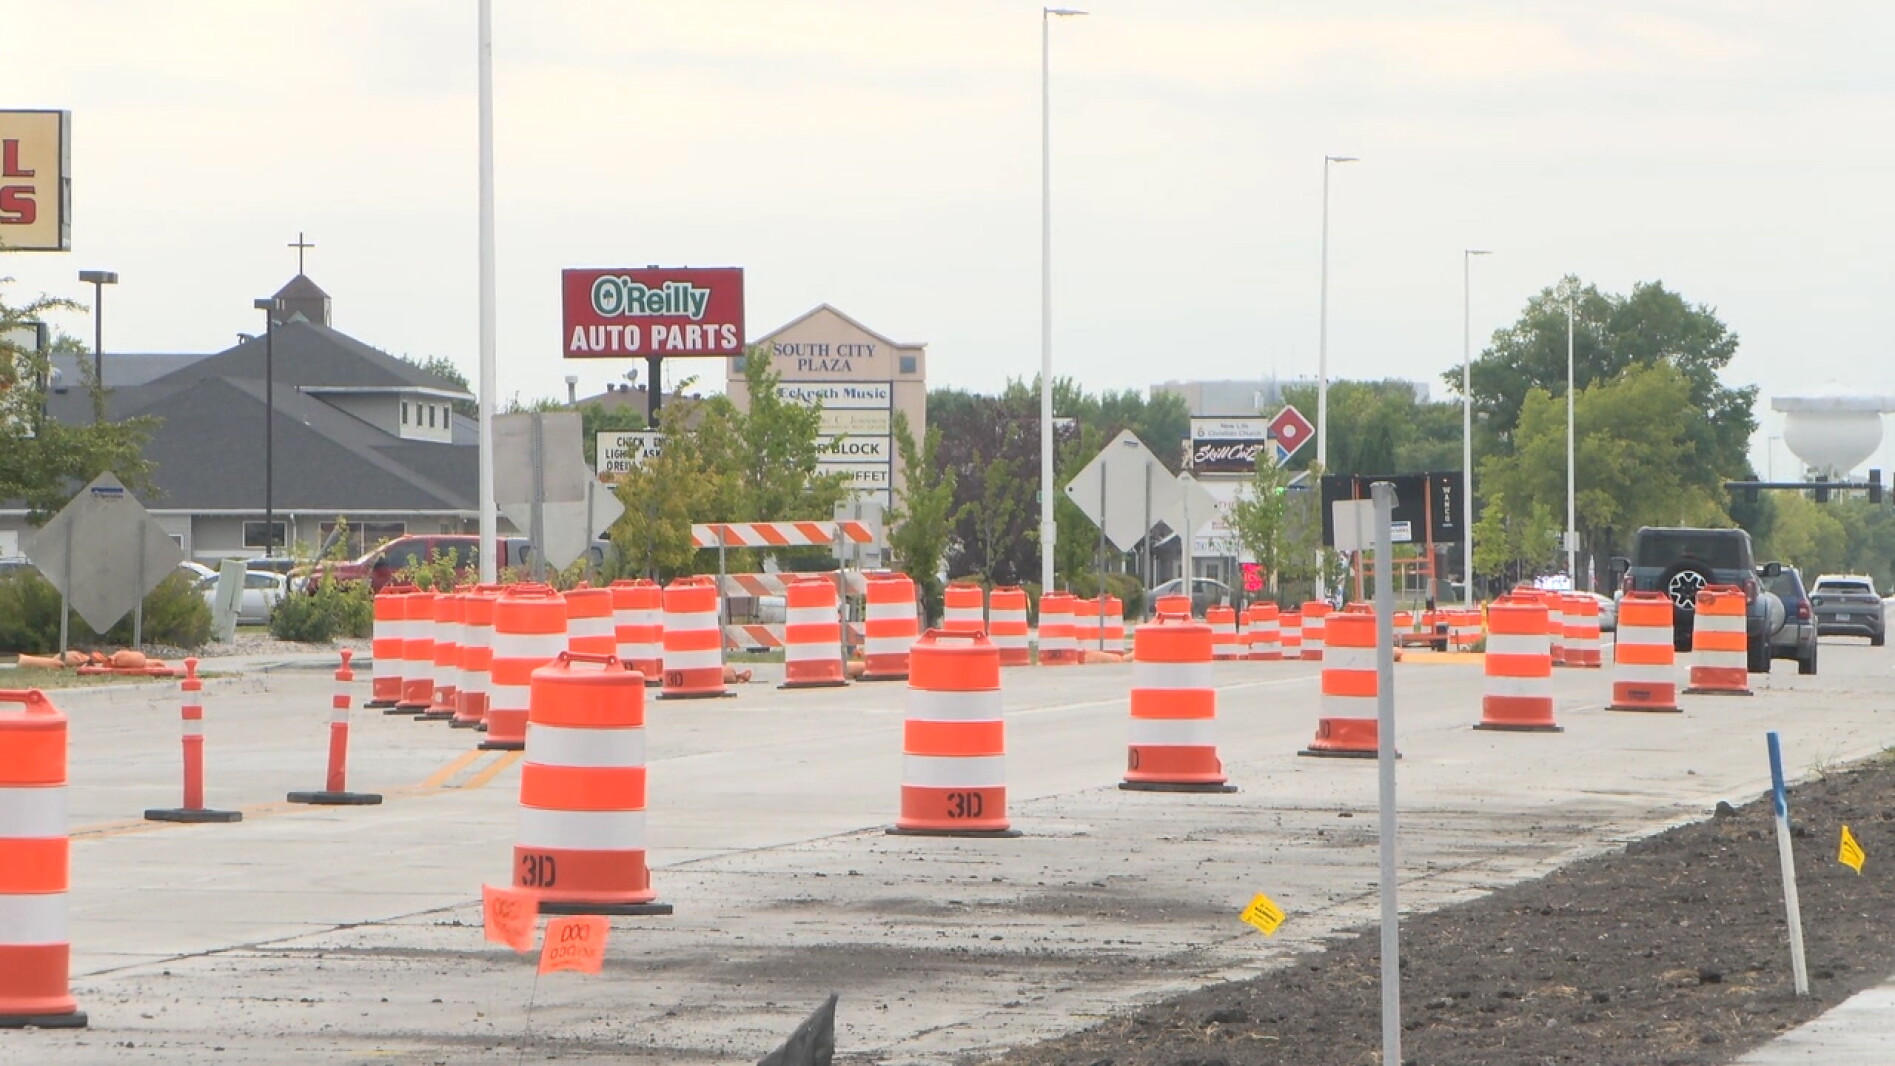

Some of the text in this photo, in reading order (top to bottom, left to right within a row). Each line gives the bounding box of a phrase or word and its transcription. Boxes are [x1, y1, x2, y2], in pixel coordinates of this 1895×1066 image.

[592, 275, 710, 320] O'Reilly
[570, 323, 737, 351] AUTO PARTS
[773, 343, 876, 357] SOUTH CITY
[797, 359, 852, 372] PLAZA
[843, 387, 887, 399] Music
[667, 671, 683, 688] 3D
[947, 791, 983, 818] 3D
[521, 855, 556, 888] 3D
